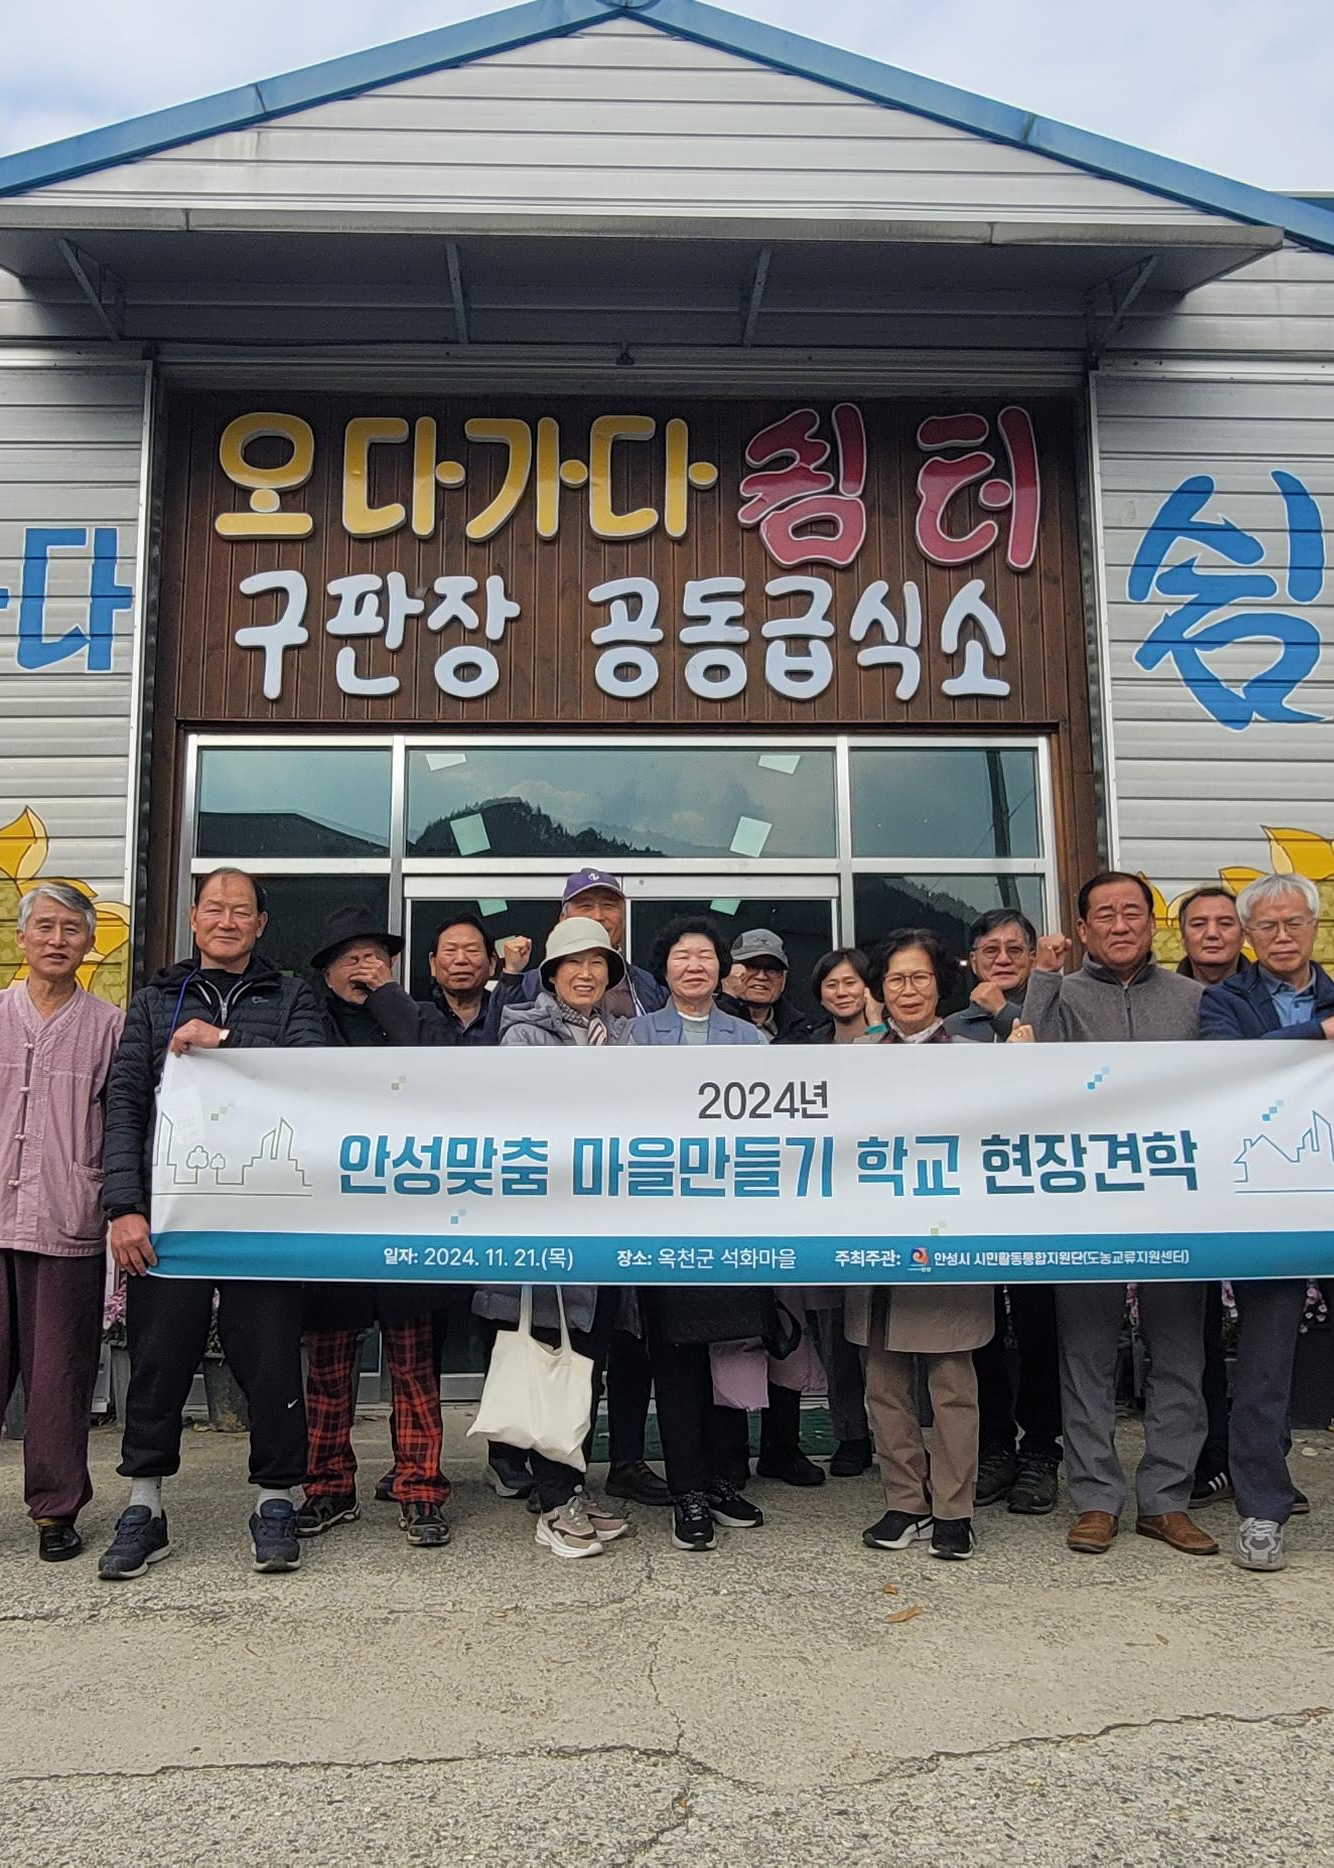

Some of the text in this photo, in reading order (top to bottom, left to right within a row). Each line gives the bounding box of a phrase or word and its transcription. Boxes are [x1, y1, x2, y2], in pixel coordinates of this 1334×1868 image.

[214, 411, 719, 543] 오다가다
[234, 570, 1011, 701] 구판장 공동급식소
[697, 1080, 830, 1120] 2024년
[338, 1129, 1199, 1199] 안성맞춤 마을만들기 학교 현장견학
[383, 1247, 574, 1271] 일자: 2024. 11. 21.(목)
[616, 1247, 797, 1270] 장소: 옥천군 석화마을
[834, 1249, 901, 1268] 주최주관:
[933, 1251, 971, 1267] 안성시
